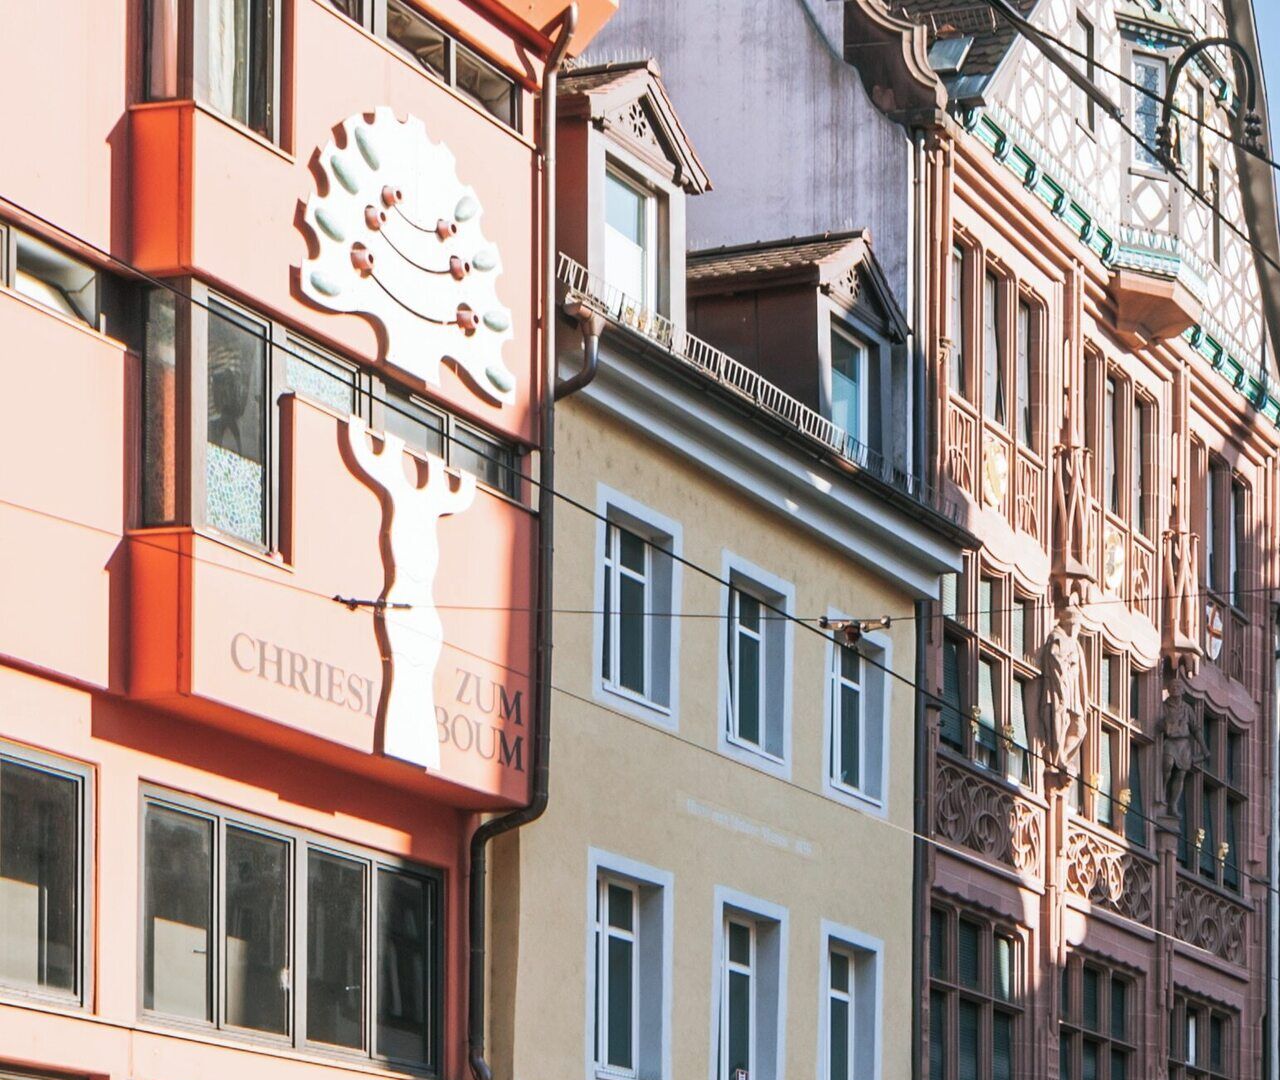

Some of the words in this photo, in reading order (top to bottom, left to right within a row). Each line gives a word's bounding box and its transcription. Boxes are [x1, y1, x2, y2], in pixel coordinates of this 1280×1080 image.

[230, 632, 374, 719] CHRIESI
[456, 668, 523, 727] ZUM
[434, 706, 524, 772] BOUM
